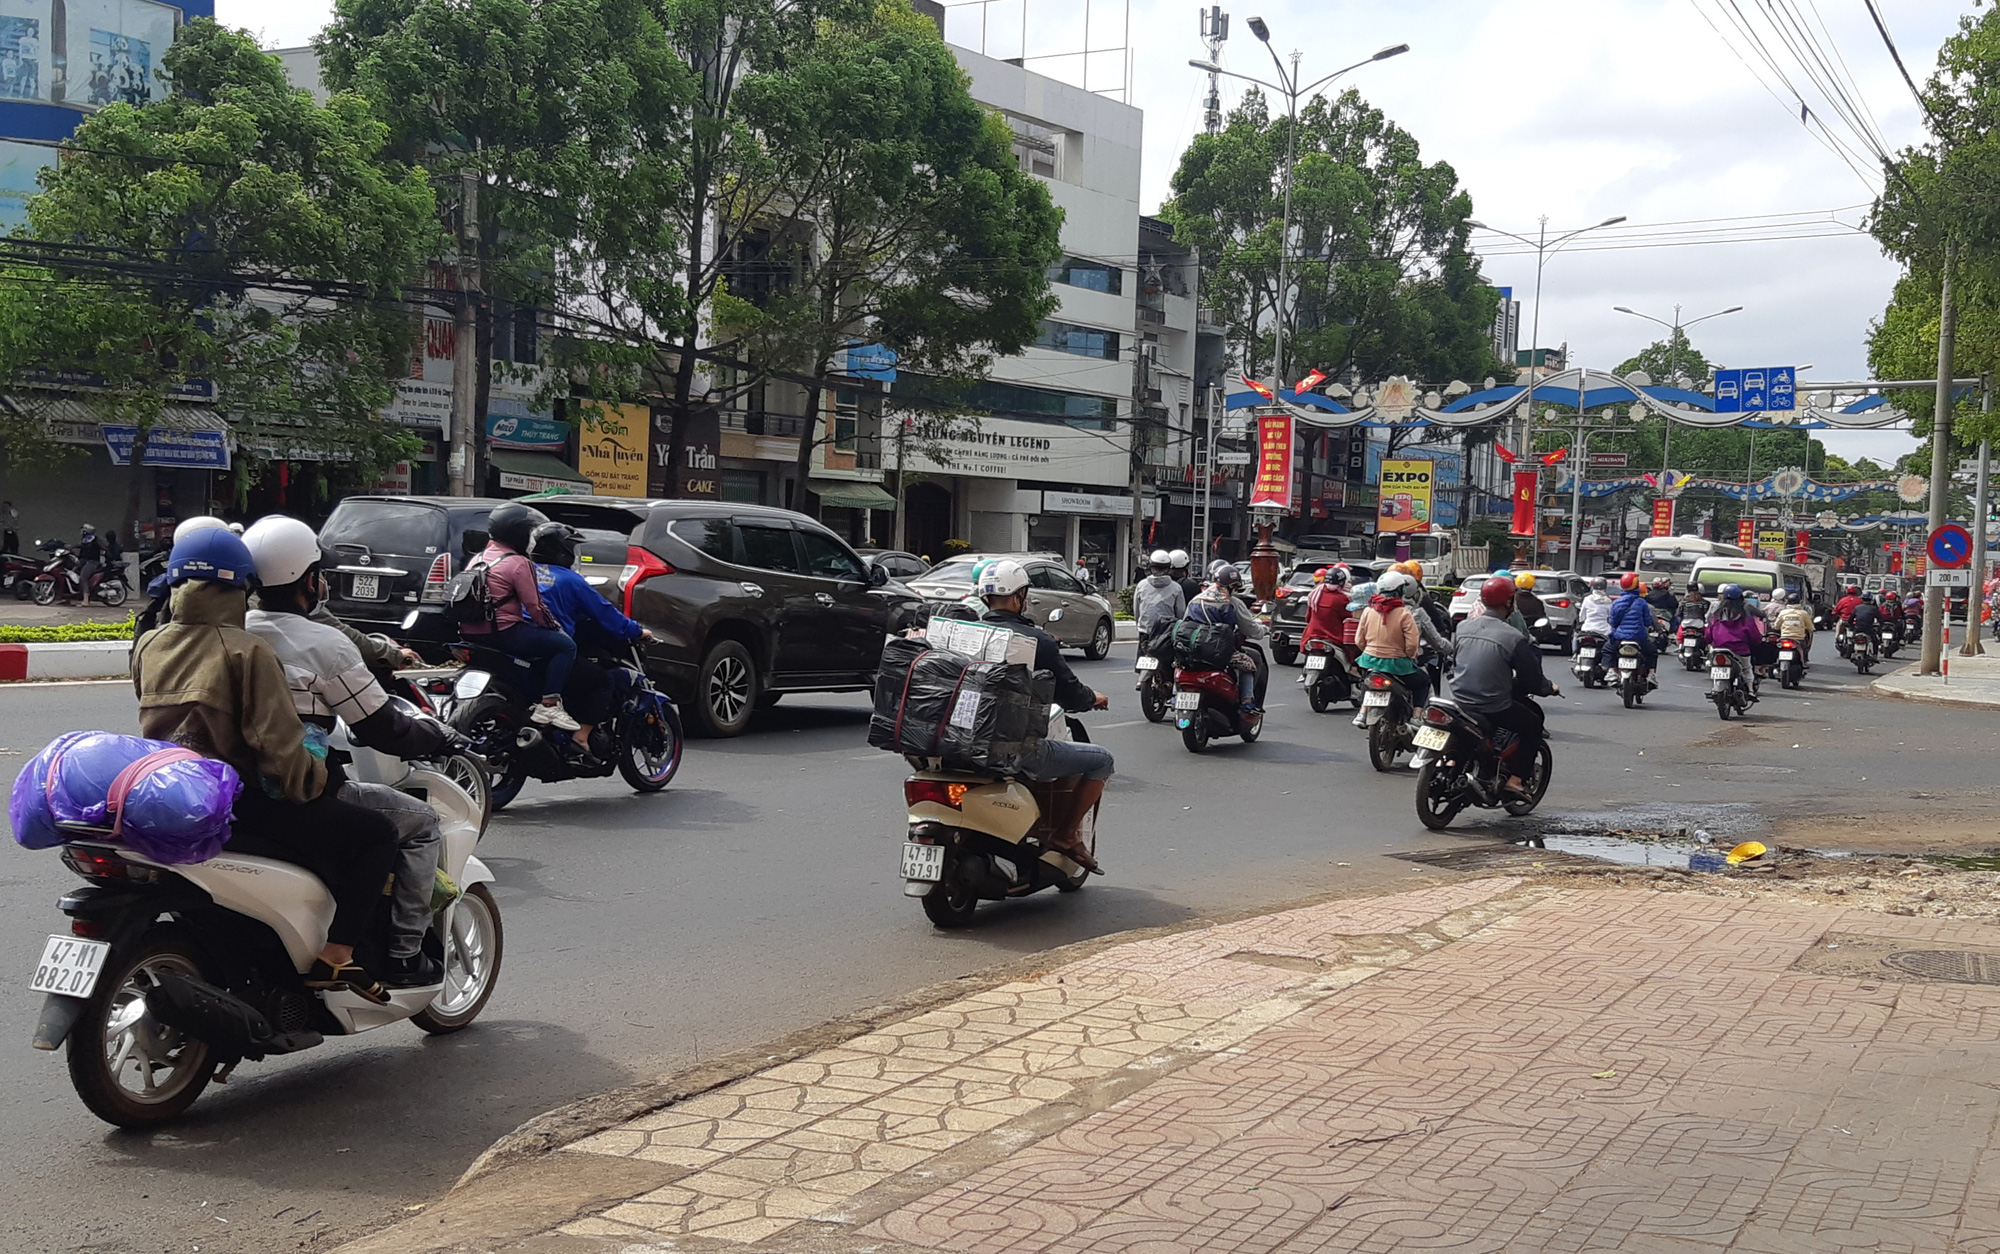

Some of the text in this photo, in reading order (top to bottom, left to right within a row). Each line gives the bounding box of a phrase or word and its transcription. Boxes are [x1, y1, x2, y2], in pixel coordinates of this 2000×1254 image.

[494, 424, 515, 433] MILO
[1010, 436, 1050, 450] LEGEND
[582, 445, 610, 459] Nhà
[685, 444, 716, 472] Trần
[1383, 472, 1429, 483] EXPO
[687, 479, 715, 494] CAKE
[1061, 497, 1091, 506] SHOWROOM
[358, 576, 374, 586] 52Z
[1939, 574, 1951, 582] 200
[355, 586, 376, 597] 2039
[908, 845, 938, 863] 47-B1
[902, 862, 940, 879] 467.91
[50, 941, 98, 968] 47-M1
[34, 965, 96, 994] 882.07
